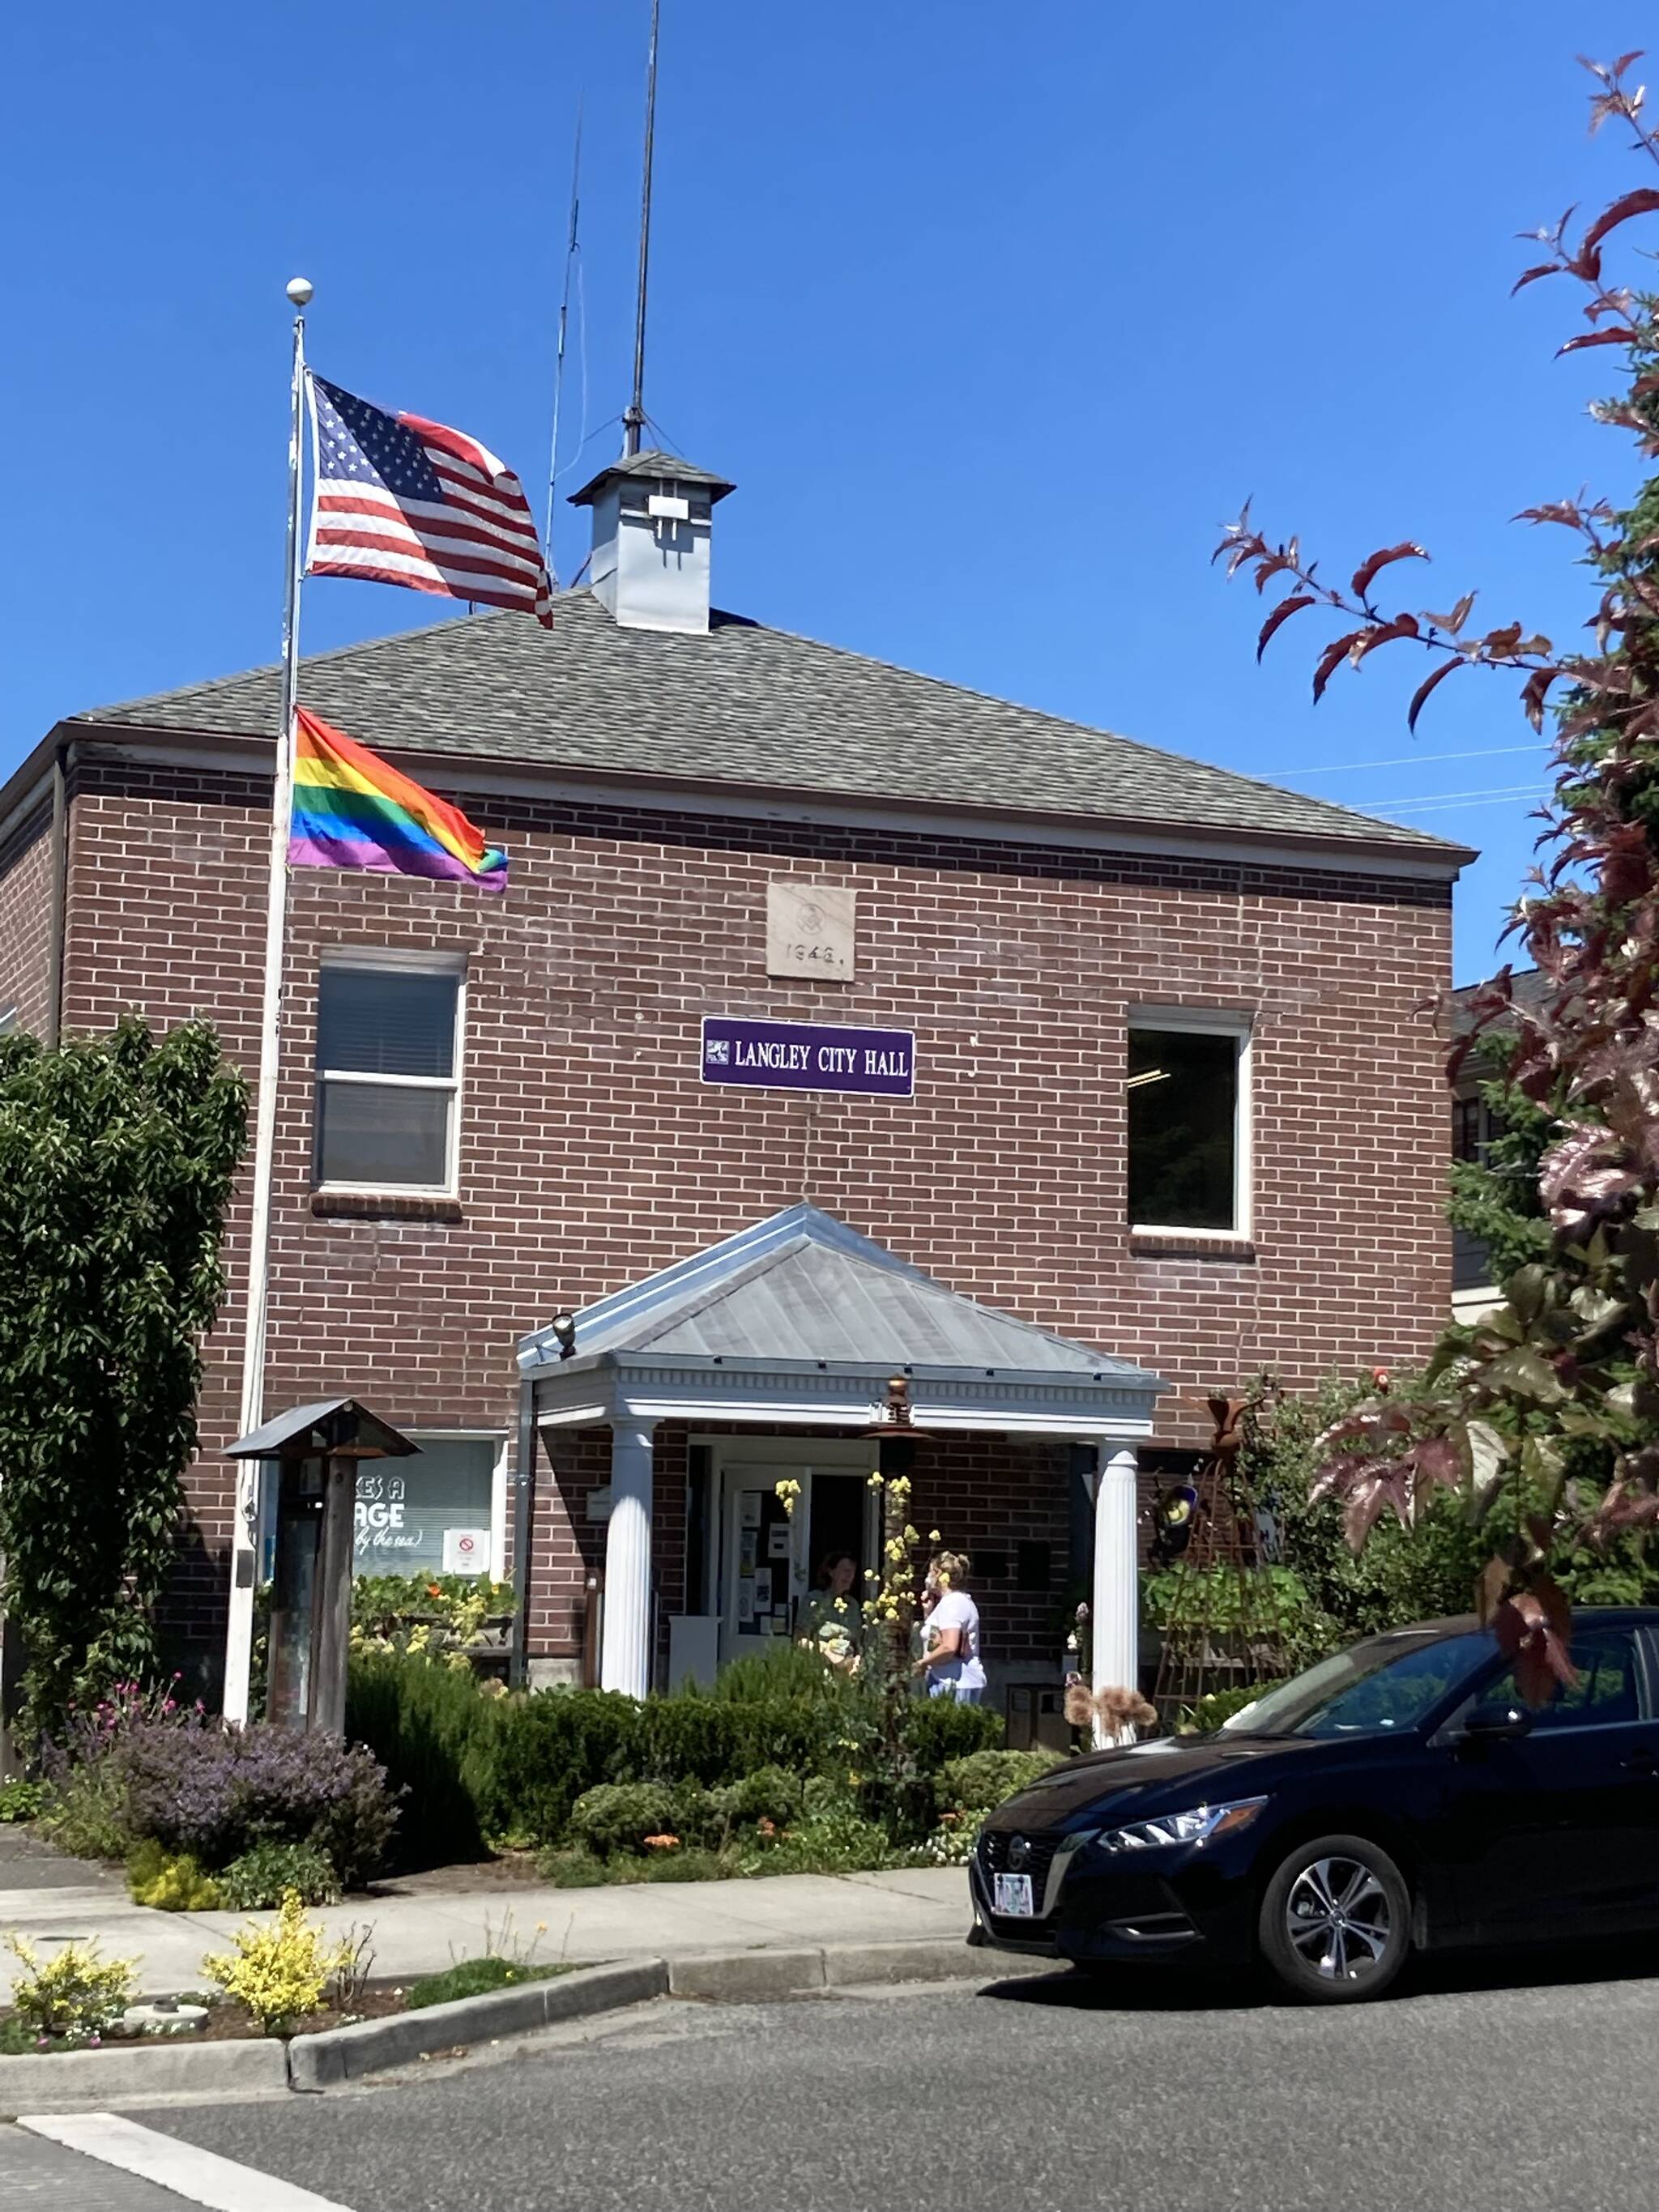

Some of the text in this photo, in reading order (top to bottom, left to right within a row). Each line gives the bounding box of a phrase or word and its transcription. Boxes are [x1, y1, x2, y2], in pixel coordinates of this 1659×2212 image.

[735, 1040, 909, 1077] LANGLEY CITY HALL
[387, 1476, 406, 1500] A
